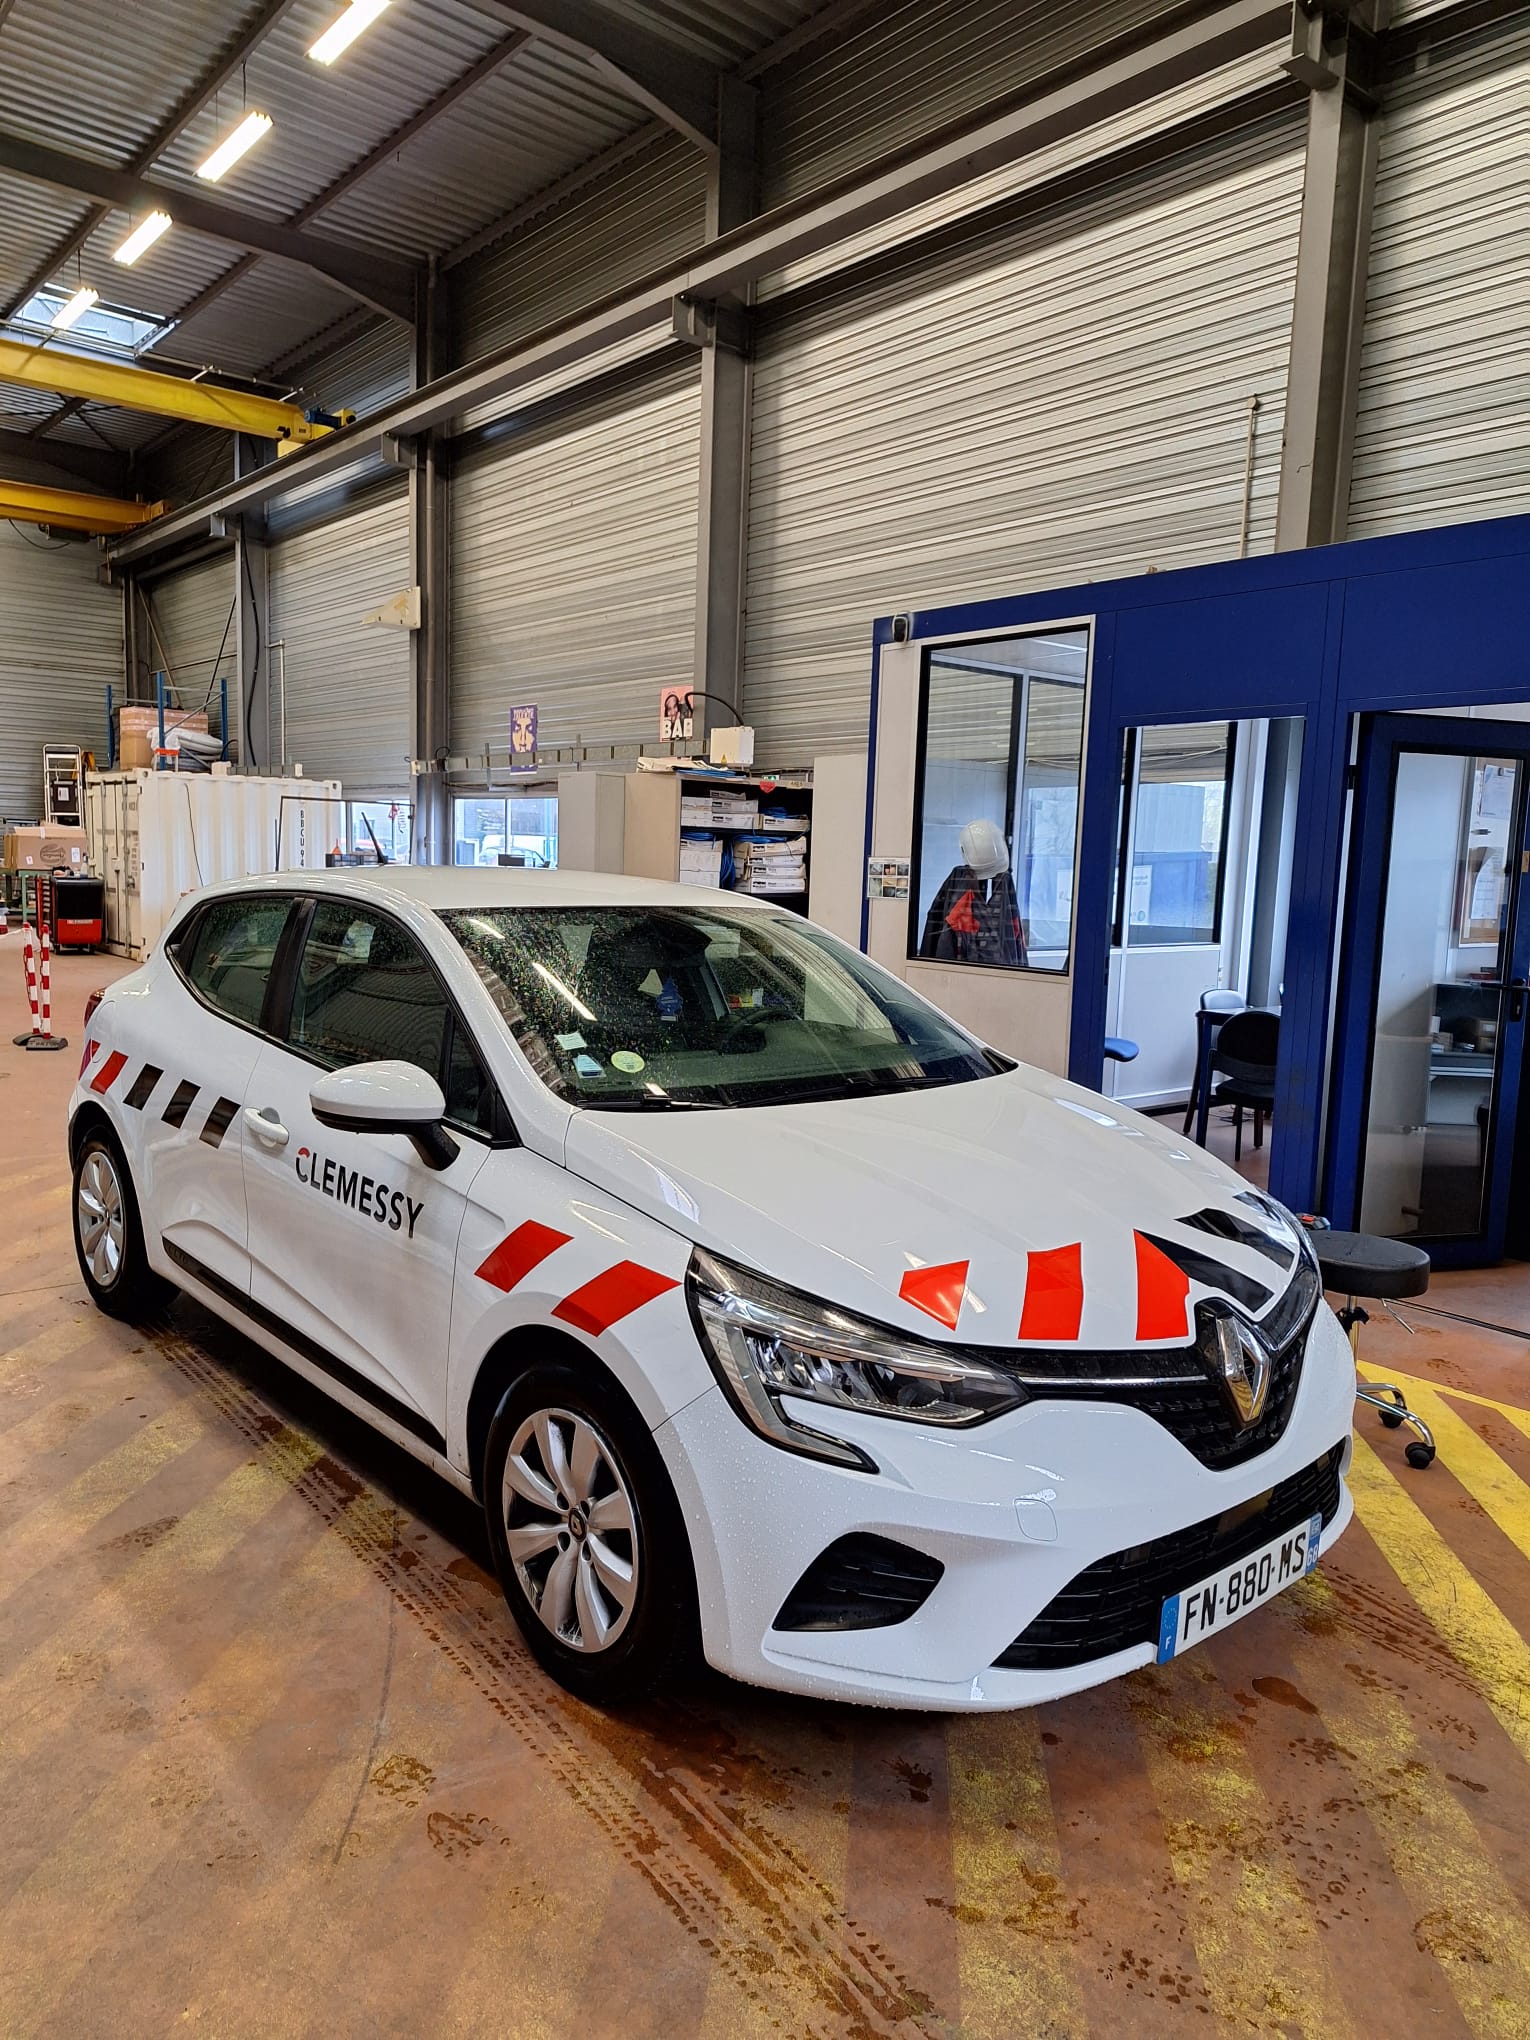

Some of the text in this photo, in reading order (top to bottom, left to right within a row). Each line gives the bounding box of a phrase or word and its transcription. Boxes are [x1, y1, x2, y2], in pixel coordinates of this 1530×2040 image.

[295, 1146, 424, 1239] CLEMESSY
[1165, 1531, 1318, 1651] F FN-880-MS 68
